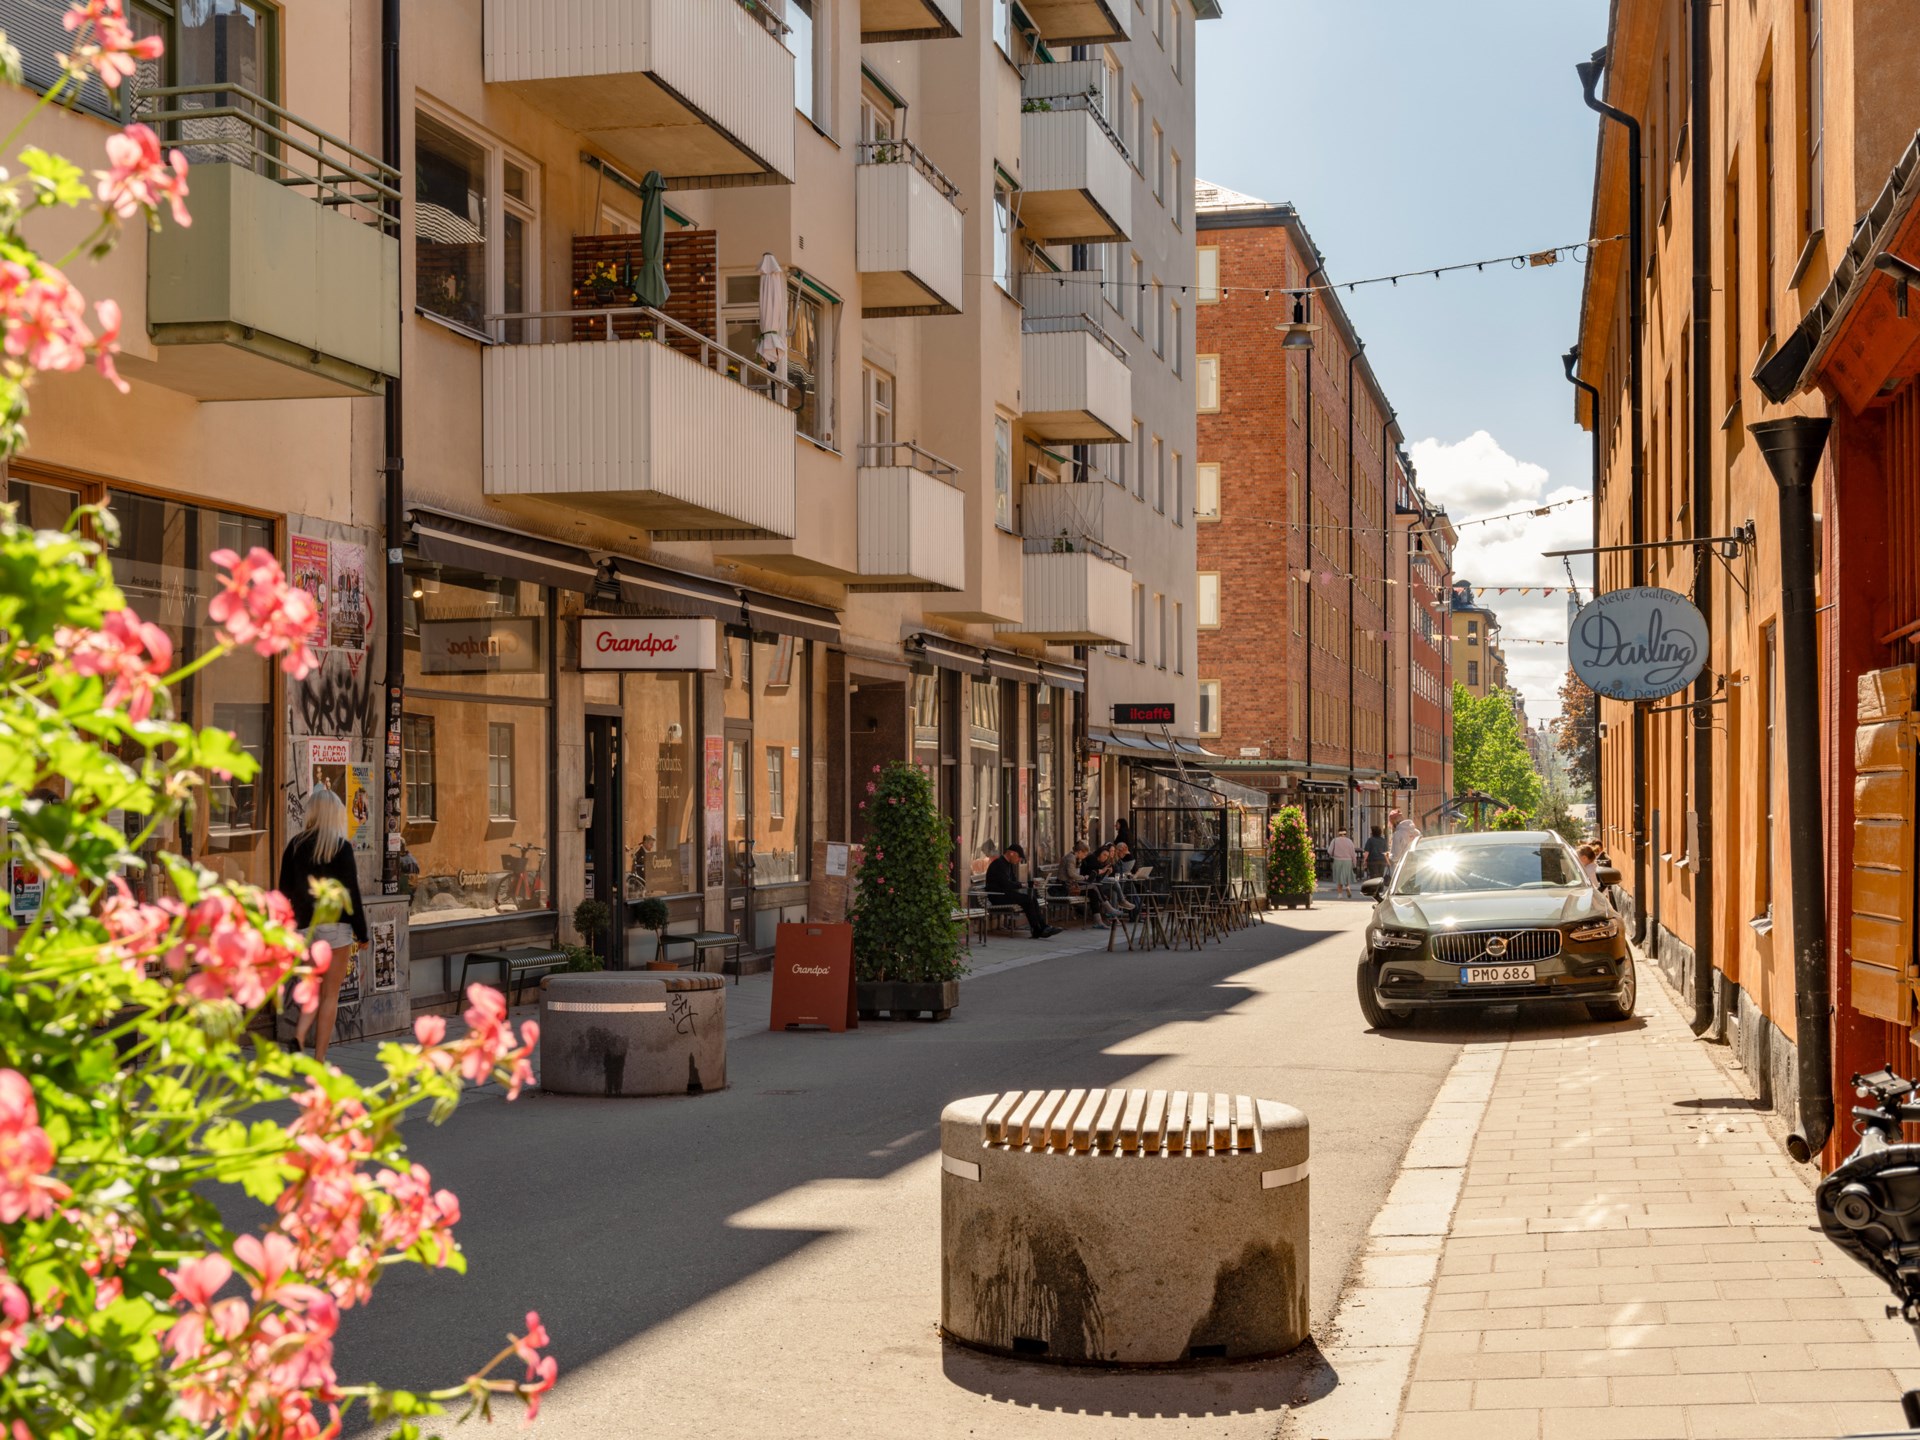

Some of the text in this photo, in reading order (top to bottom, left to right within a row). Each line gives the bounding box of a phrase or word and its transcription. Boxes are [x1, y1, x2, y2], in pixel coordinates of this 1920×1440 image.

[597, 631, 678, 657] Grandpa
[1581, 608, 1697, 685] Darling
[458, 869, 488, 889] Grandpa
[792, 963, 830, 977] Grandpa
[1472, 967, 1530, 981] PMO 686
